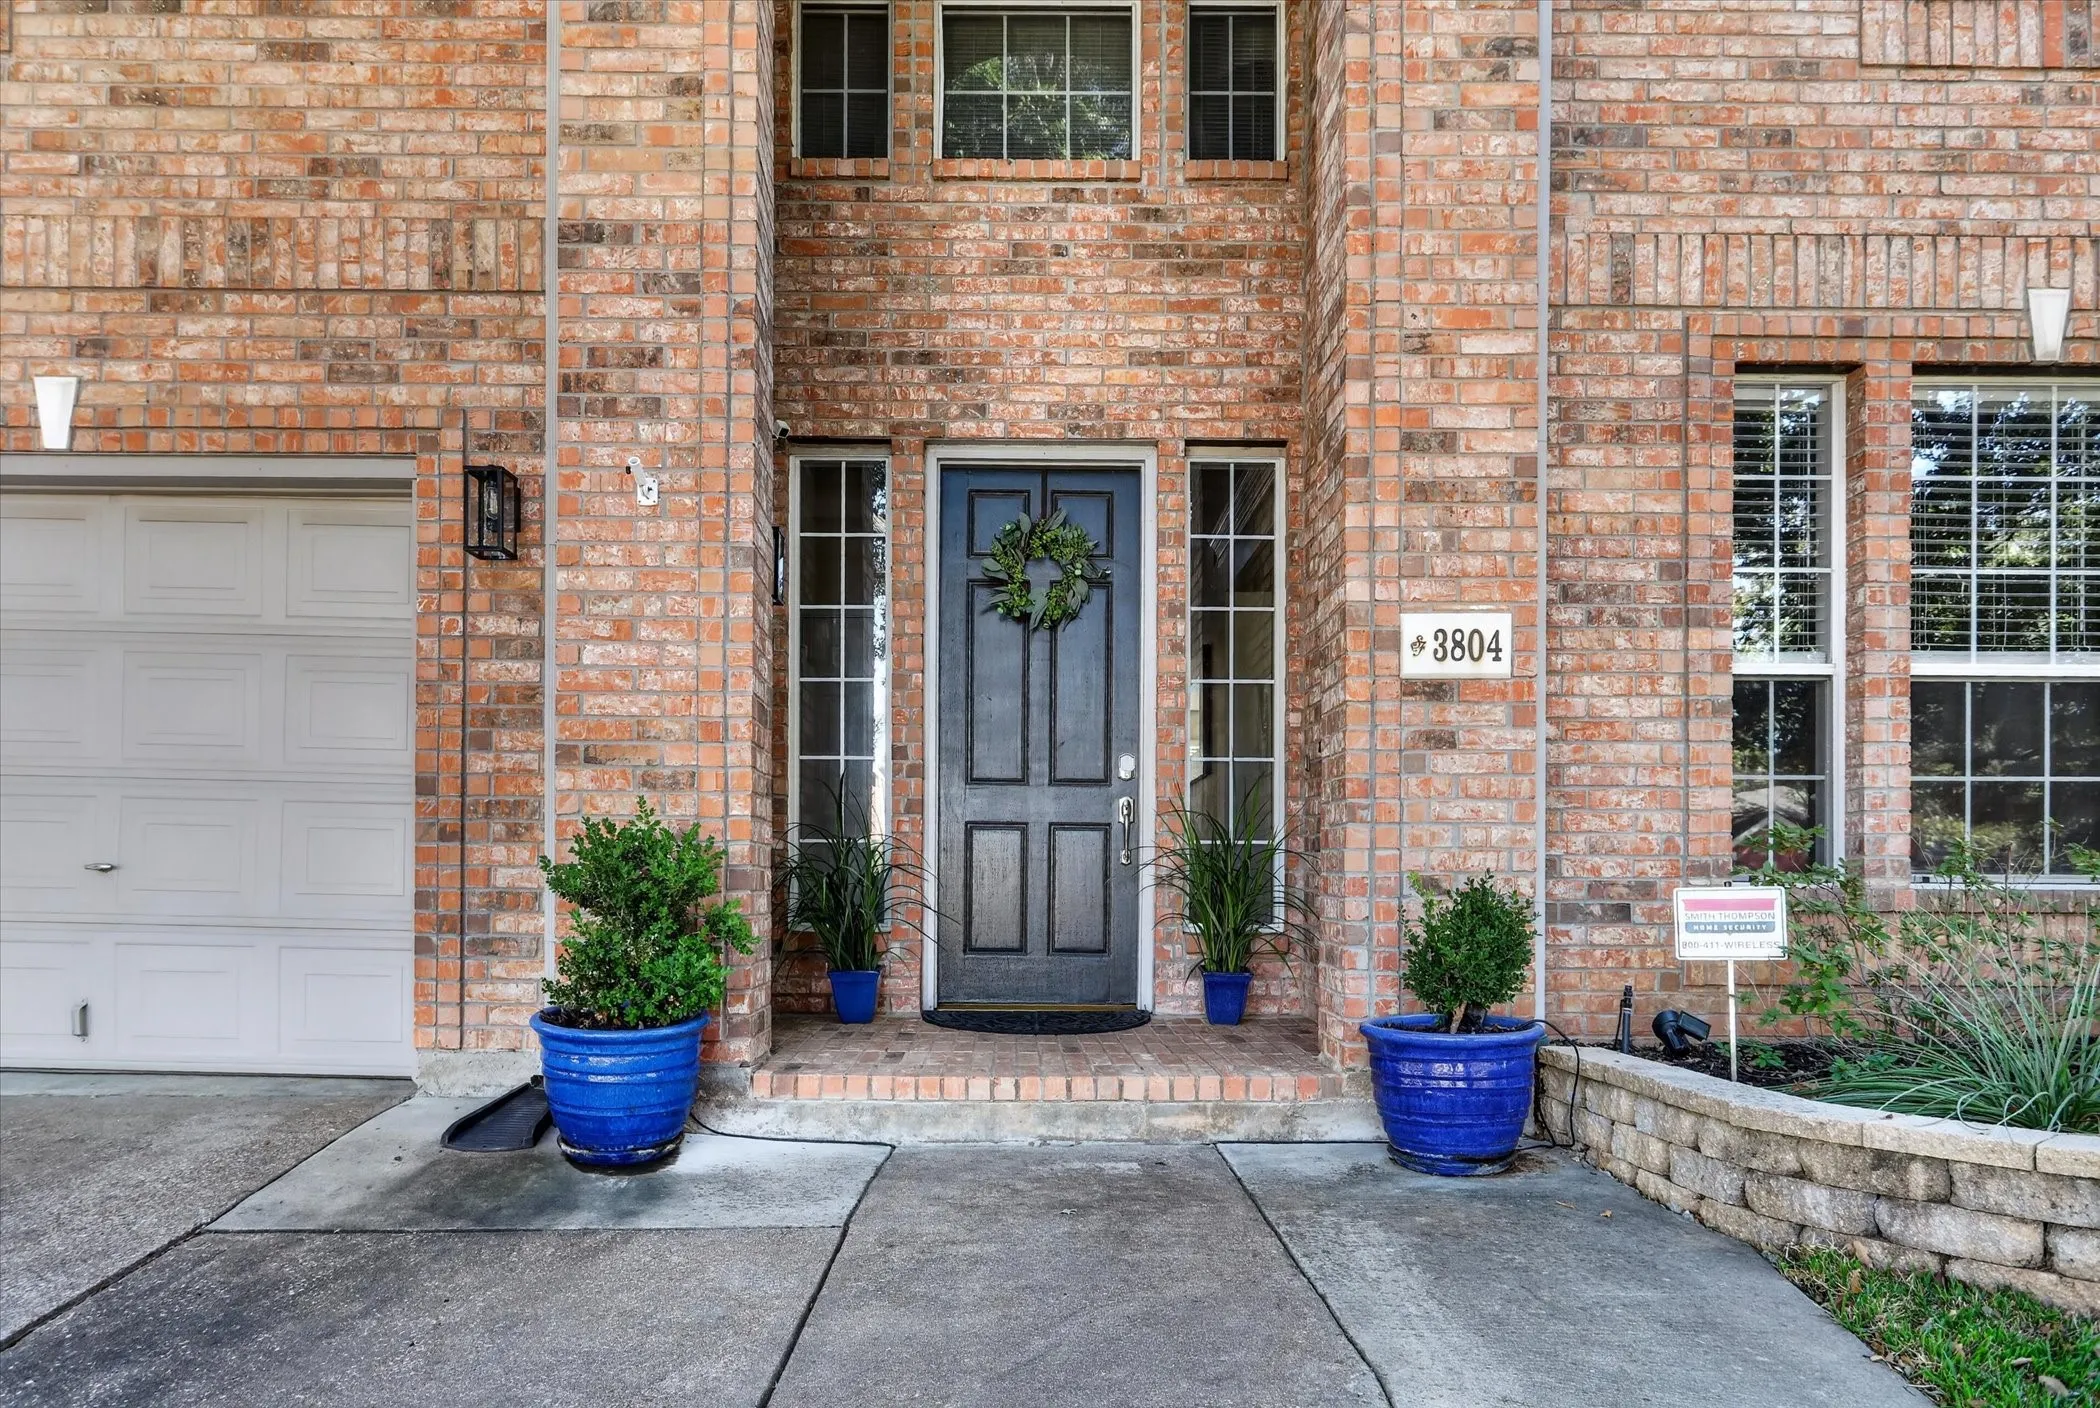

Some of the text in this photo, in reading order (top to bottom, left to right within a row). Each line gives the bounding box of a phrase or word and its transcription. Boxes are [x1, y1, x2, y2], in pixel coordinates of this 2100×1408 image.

[1433, 628, 1502, 662] 3804
[1684, 912, 1776, 920] SMITH THOMPSON
[1682, 941, 1780, 949] 800-411-WIRELESS
